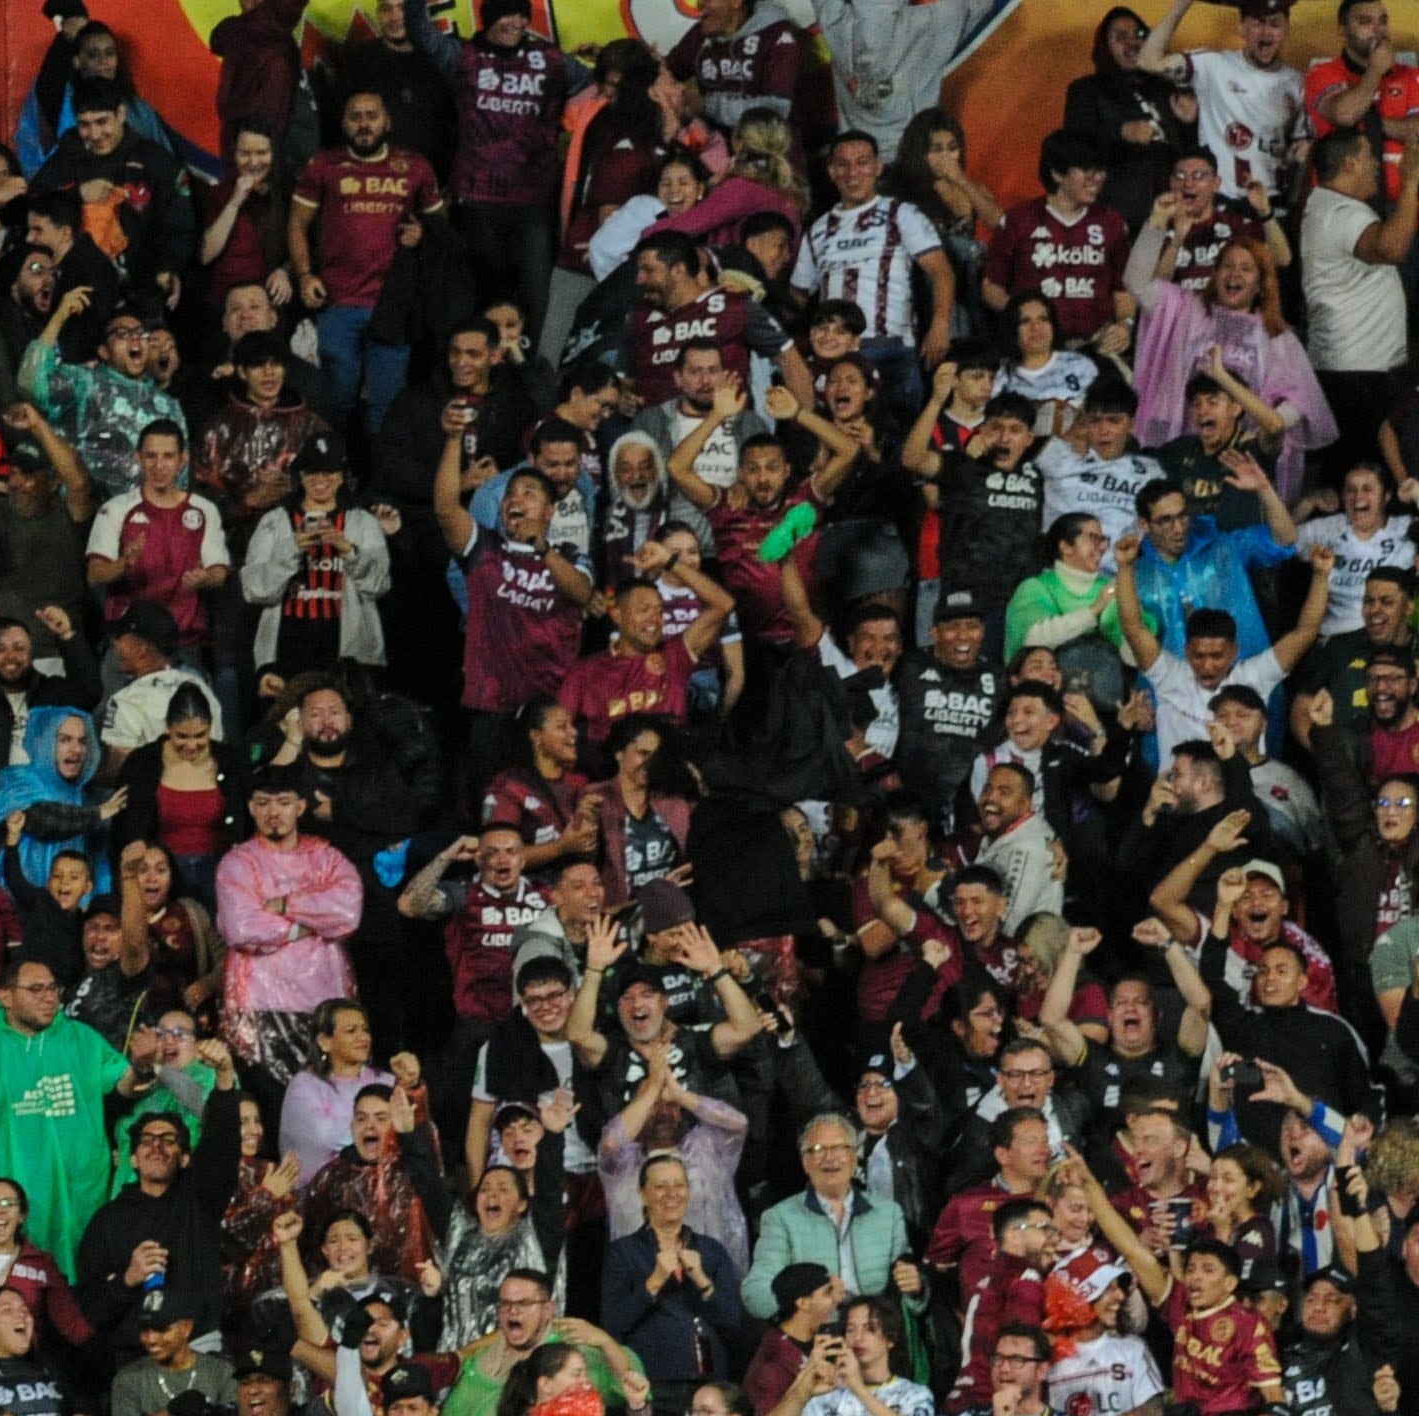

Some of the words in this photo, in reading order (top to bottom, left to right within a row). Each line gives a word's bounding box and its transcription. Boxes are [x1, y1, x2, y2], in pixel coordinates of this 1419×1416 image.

[744, 36, 758, 54] S
[721, 60, 751, 79] BAC
[502, 74, 545, 95] BAC
[365, 178, 407, 197] BAC
[1087, 225, 1101, 244] S
[1064, 278, 1094, 298] BAC
[708, 295, 725, 313] S
[674, 319, 716, 341] BAC
[947, 691, 992, 716] BAC
[1109, 1363, 1126, 1381] S
[16, 1383, 62, 1403] BAC
